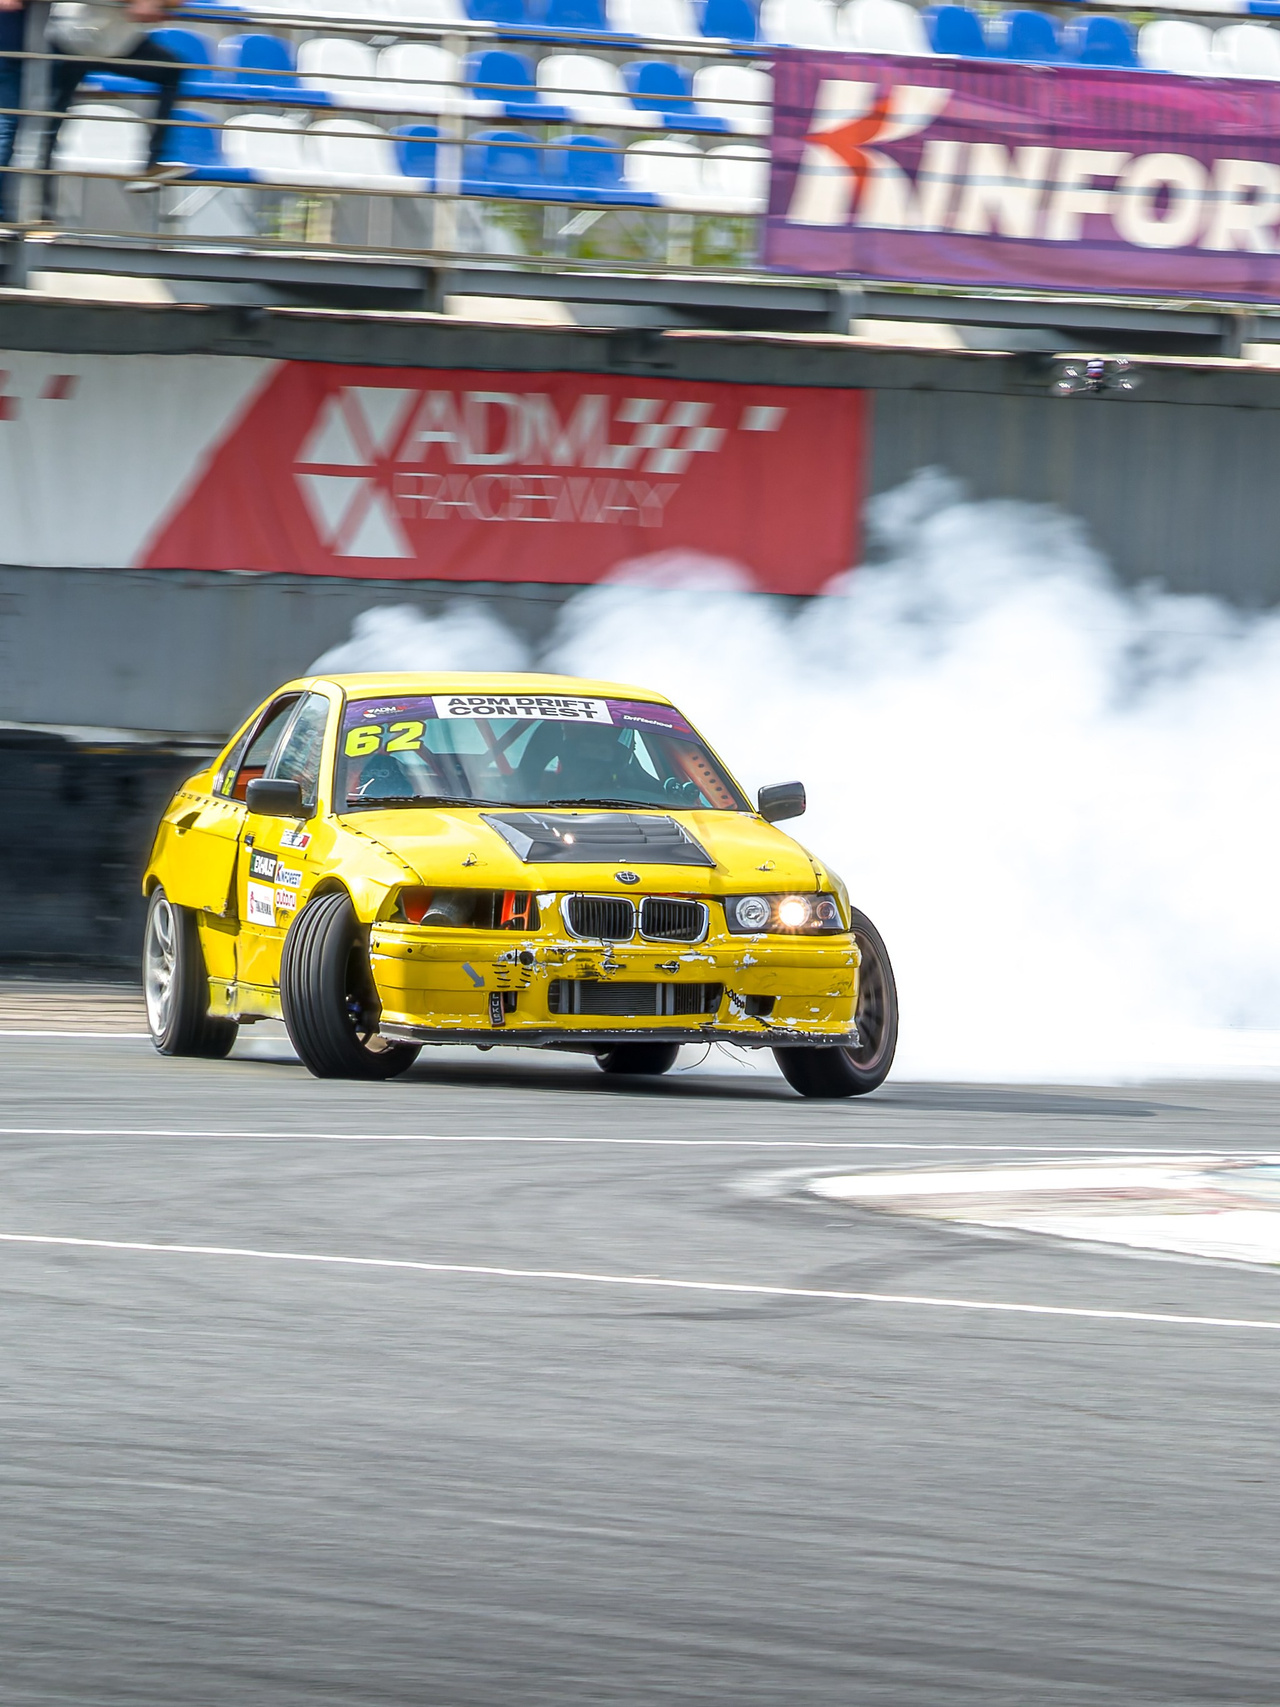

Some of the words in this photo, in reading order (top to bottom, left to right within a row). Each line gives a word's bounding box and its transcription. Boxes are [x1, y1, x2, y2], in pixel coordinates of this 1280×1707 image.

[398, 388, 614, 469] ADM
[392, 473, 681, 528] RACEWAY
[448, 698, 511, 707] ADM
[515, 697, 595, 709] DRIFT
[449, 705, 598, 719] CONTEST
[344, 721, 424, 757] 62
